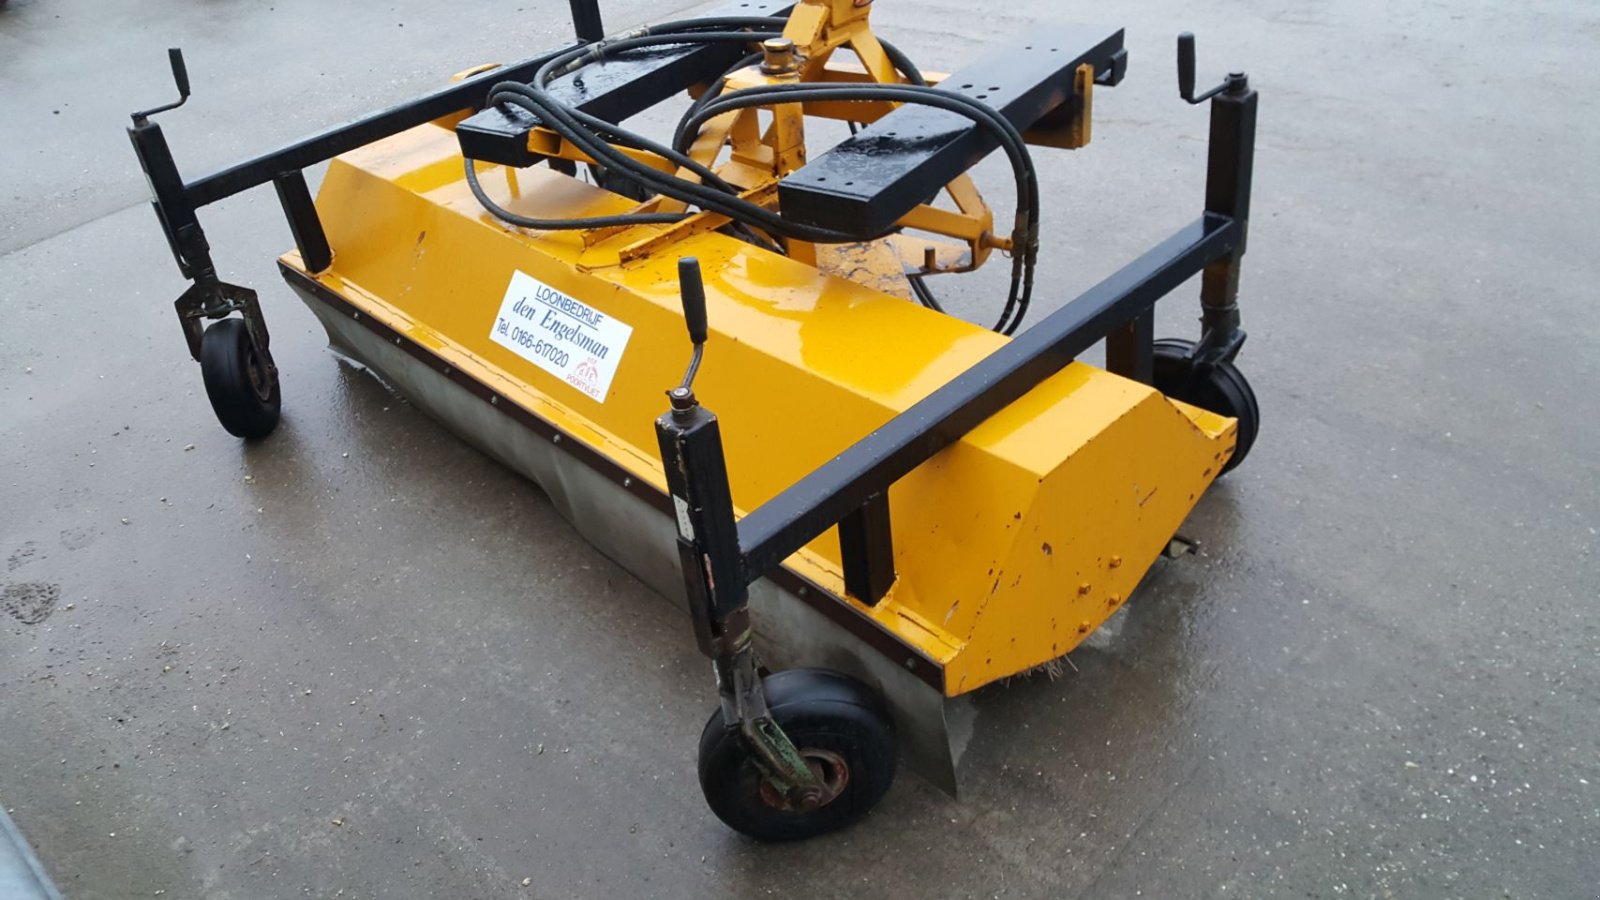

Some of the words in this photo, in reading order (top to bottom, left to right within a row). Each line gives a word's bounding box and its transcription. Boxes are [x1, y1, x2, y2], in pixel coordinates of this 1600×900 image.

[536, 285, 604, 326] LOONBEDRIJF
[511, 326, 569, 368] 0166-617020
[513, 297, 536, 320] den
[540, 309, 609, 359] Engelsman
